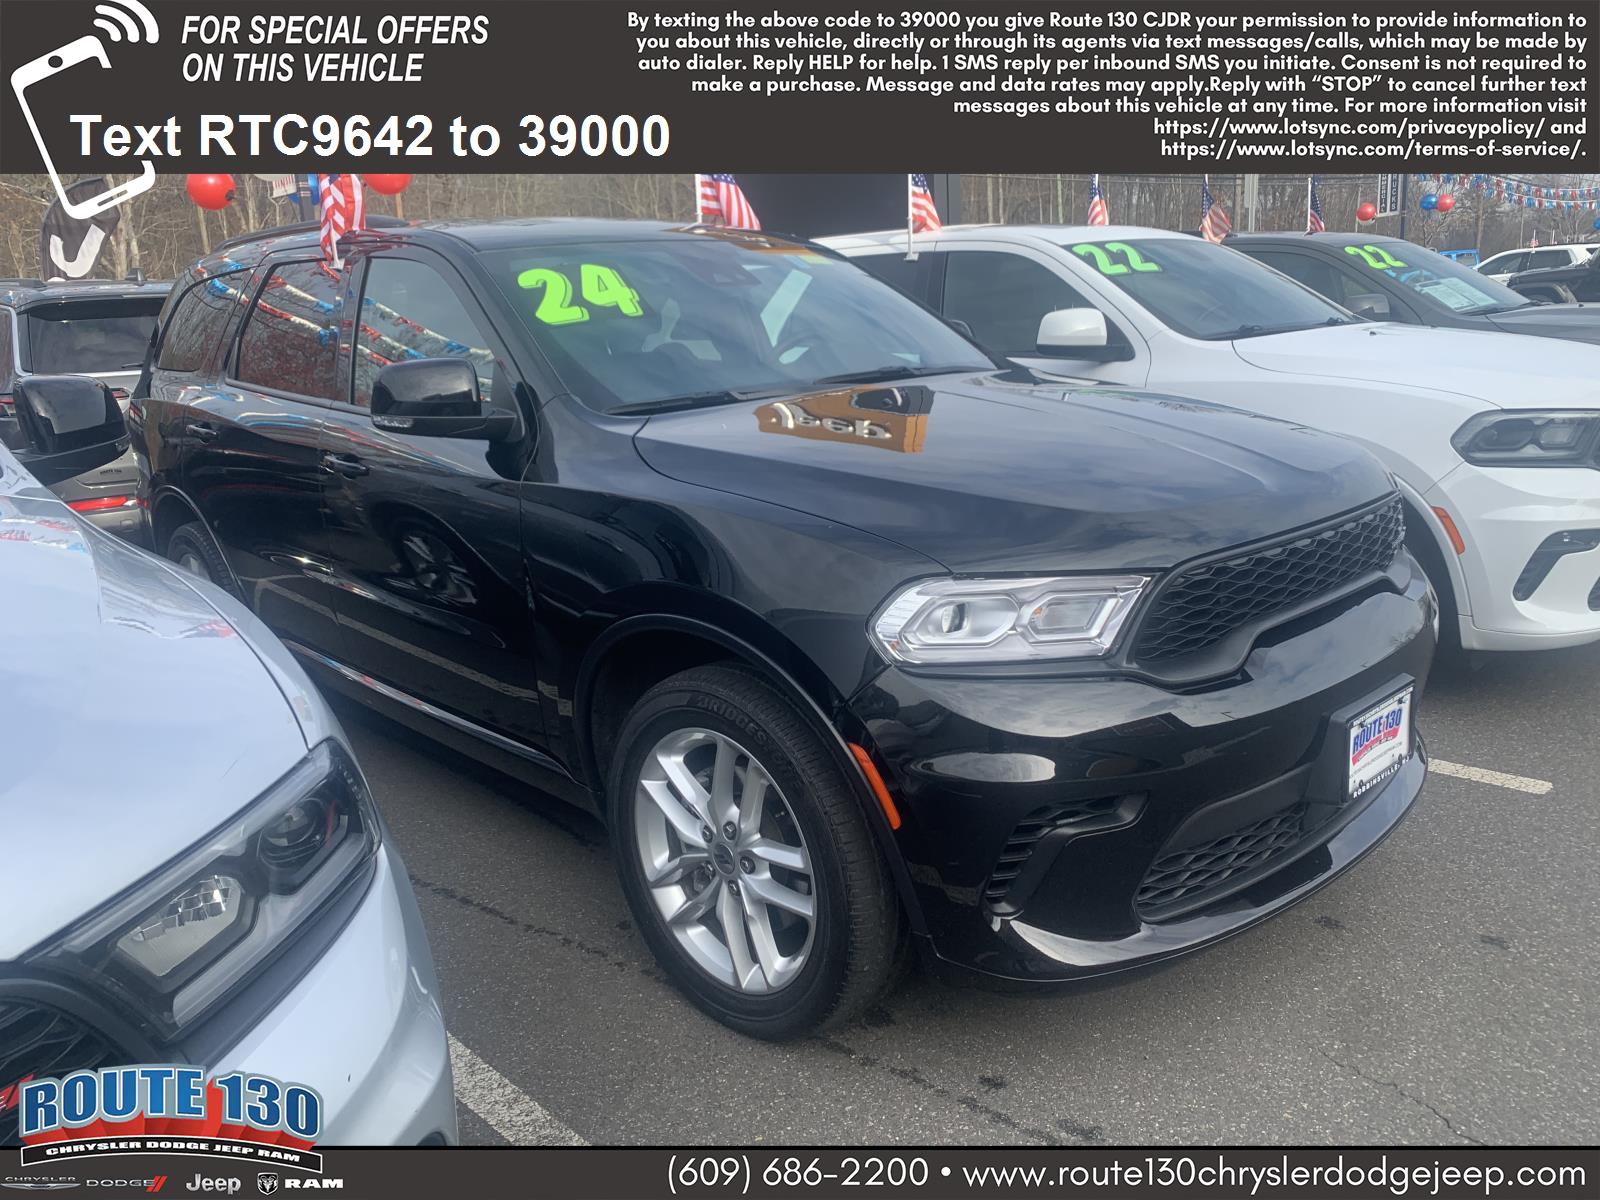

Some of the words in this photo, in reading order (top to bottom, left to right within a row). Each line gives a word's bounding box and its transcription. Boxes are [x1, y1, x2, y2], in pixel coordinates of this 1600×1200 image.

[1391, 174, 1399, 210] RUCKS
[1072, 242, 1163, 276] 22
[1344, 245, 1409, 270] 22
[517, 263, 644, 326] 24
[1352, 715, 1386, 754] ROUTE
[1385, 708, 1402, 730] 130
